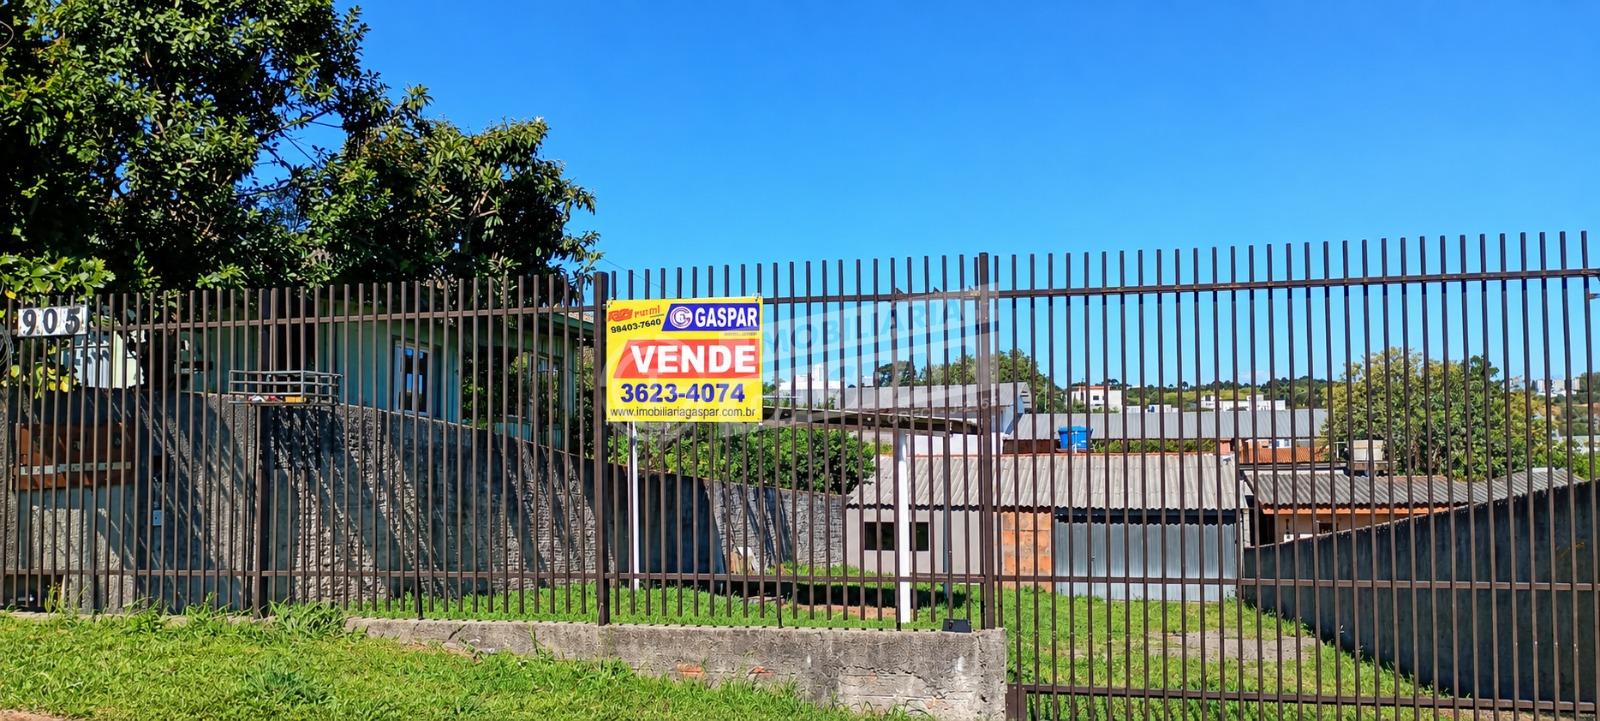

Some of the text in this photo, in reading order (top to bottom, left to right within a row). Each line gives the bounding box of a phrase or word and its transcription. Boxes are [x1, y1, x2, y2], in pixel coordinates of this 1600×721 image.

[22, 308, 81, 336] 905
[695, 307, 758, 328] GASPAR
[630, 345, 756, 374] VENDE
[620, 383, 746, 403] 3623-4074
[610, 406, 756, 420] www.imobiliariagaspar.com.br
